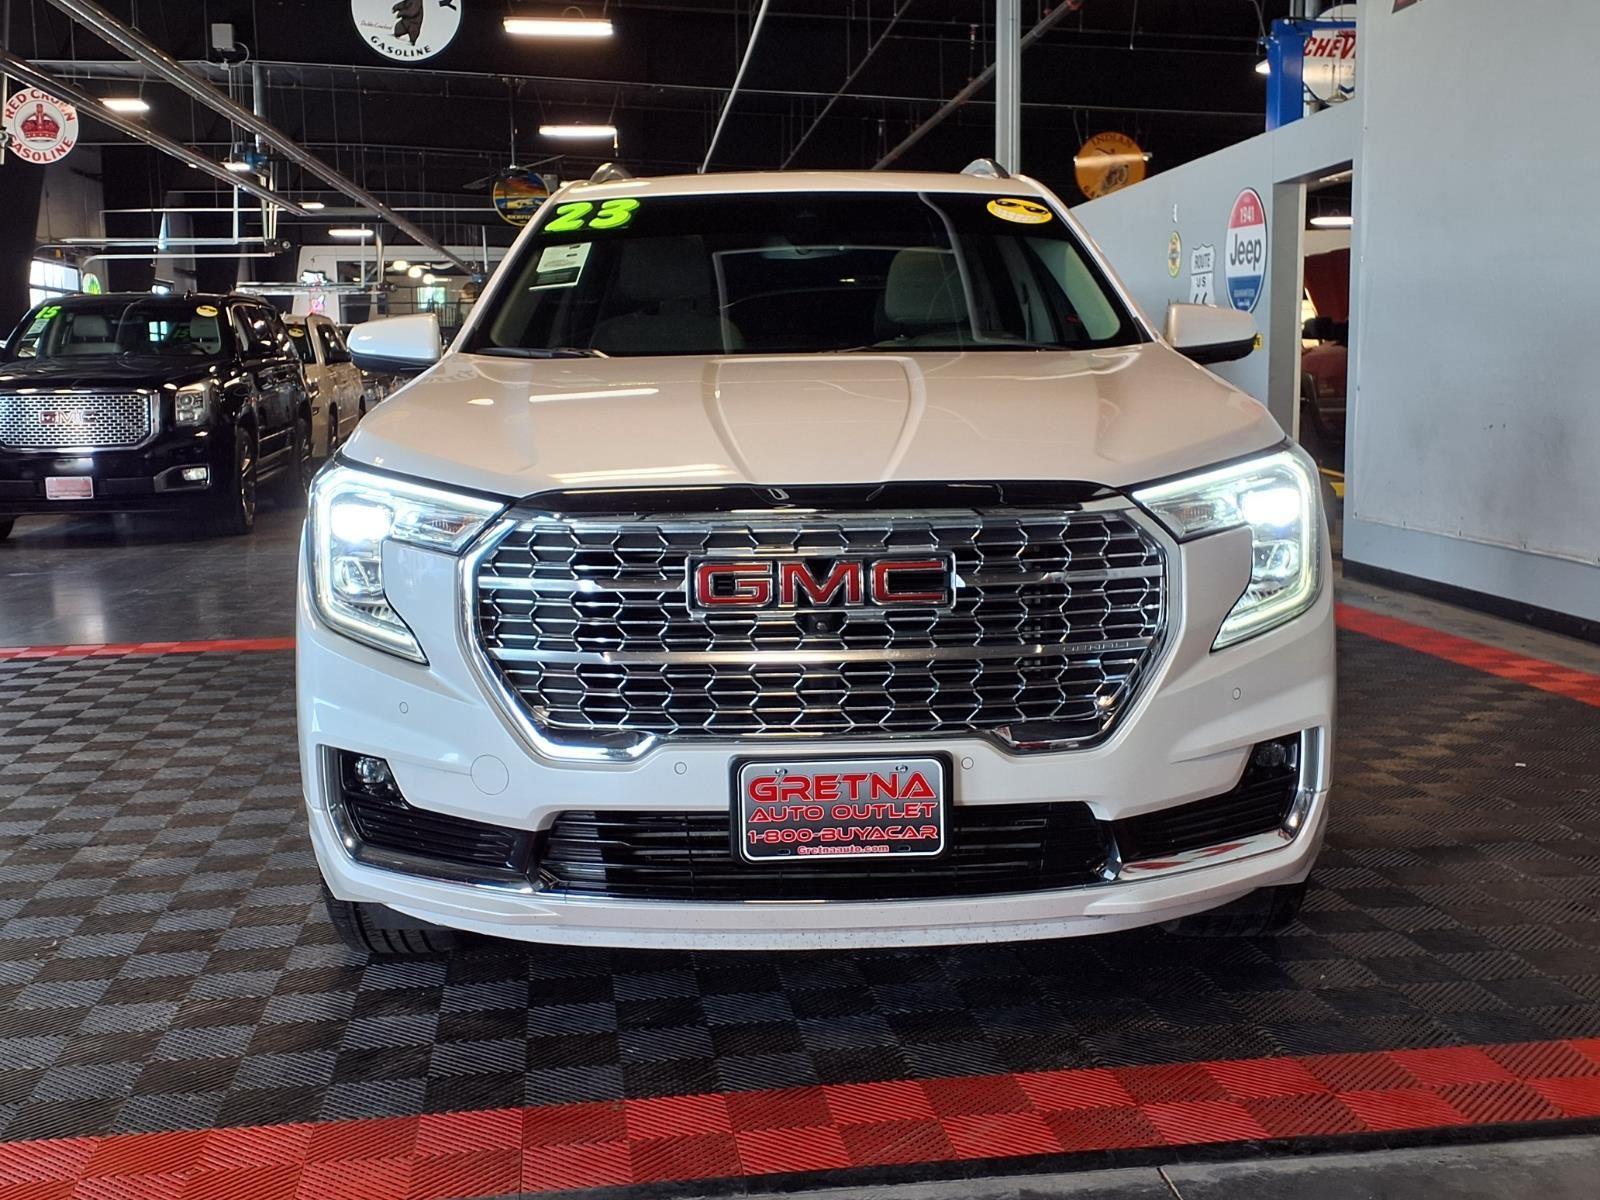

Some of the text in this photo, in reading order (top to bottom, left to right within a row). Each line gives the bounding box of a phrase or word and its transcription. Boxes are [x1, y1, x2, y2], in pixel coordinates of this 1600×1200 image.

[370, 35, 432, 57] GASOLINE
[1303, 32, 1355, 60] CHEV
[5, 89, 75, 121] RED CRN
[544, 198, 641, 233] 23
[1240, 206, 1255, 224] 1941
[1194, 253, 1211, 269] ROUTE
[1230, 233, 1262, 271] Jeep
[35, 305, 63, 319] 15
[696, 559, 949, 607] GMC
[748, 771, 938, 802] GRETNA
[748, 802, 939, 823] AUTO OUTLET
[748, 825, 938, 844] 1-800-BUYACAR
[797, 844, 890, 855] Gretnaauto.com
